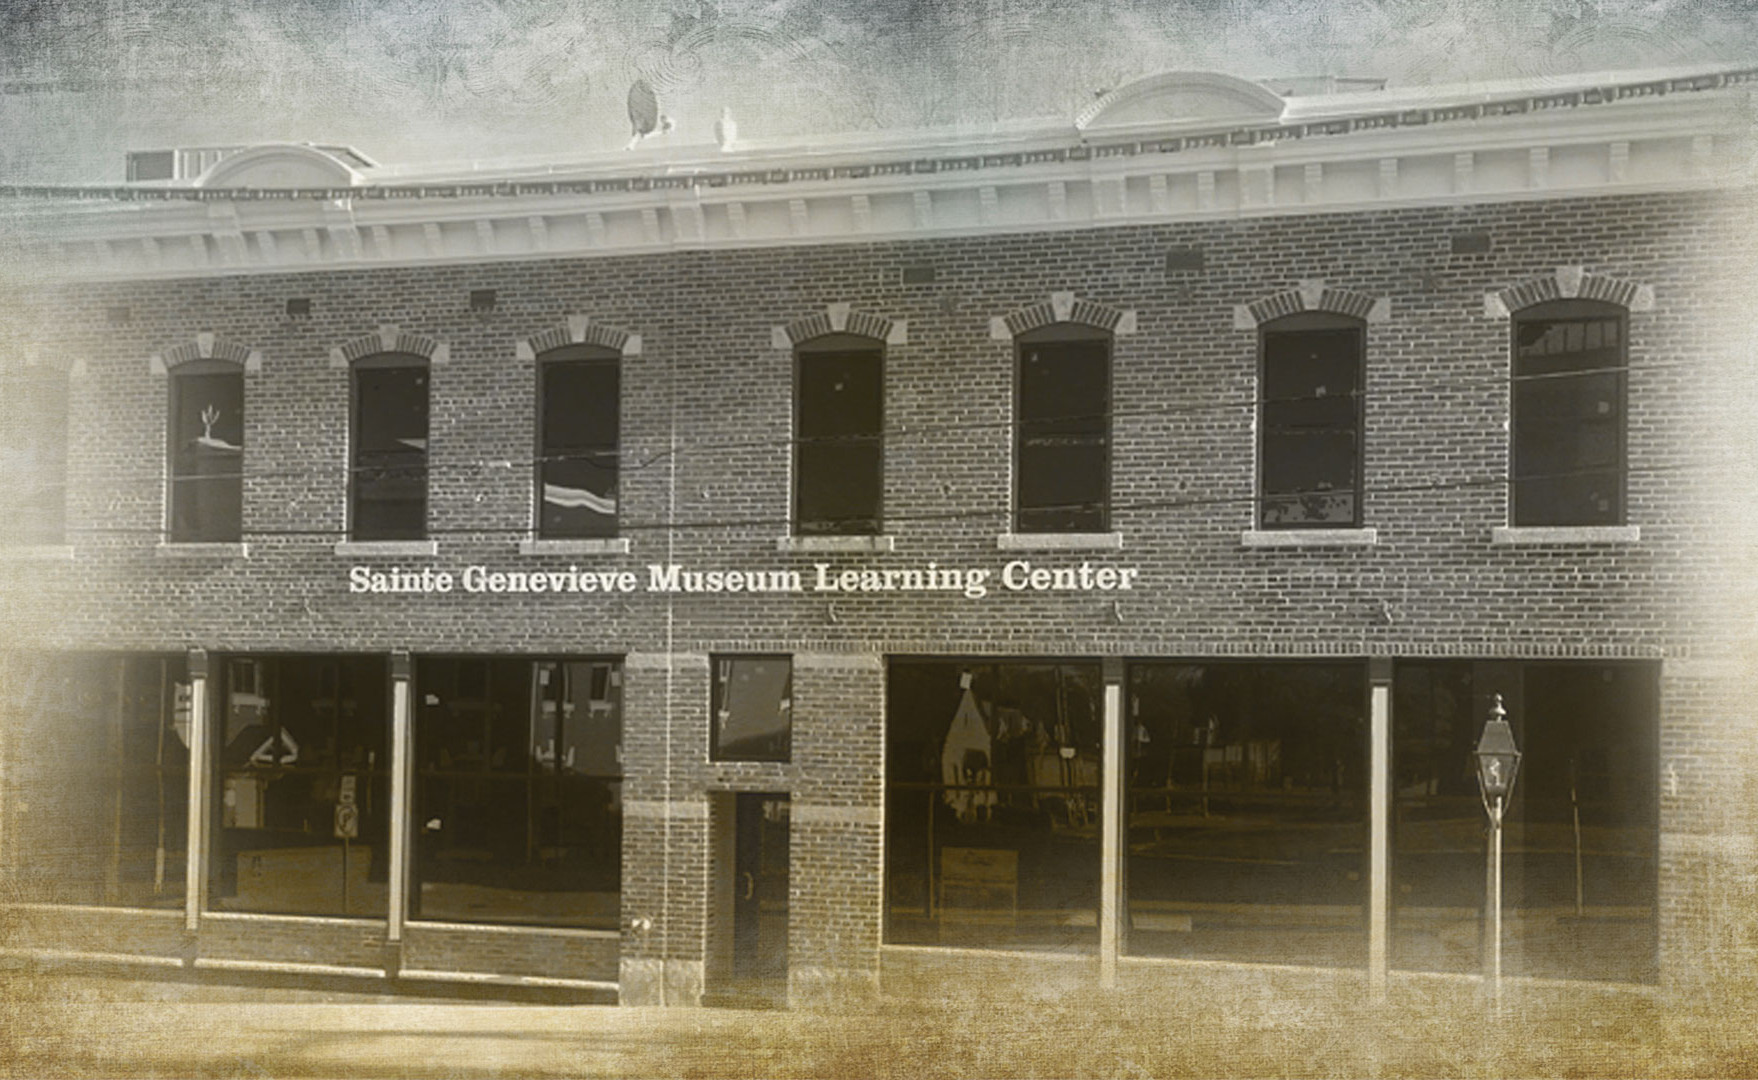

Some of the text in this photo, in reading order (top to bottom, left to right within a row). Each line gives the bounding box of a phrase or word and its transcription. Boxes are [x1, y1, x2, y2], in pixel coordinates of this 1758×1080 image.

[349, 560, 1138, 598] Sainte Genevieve Museum Learning Center
